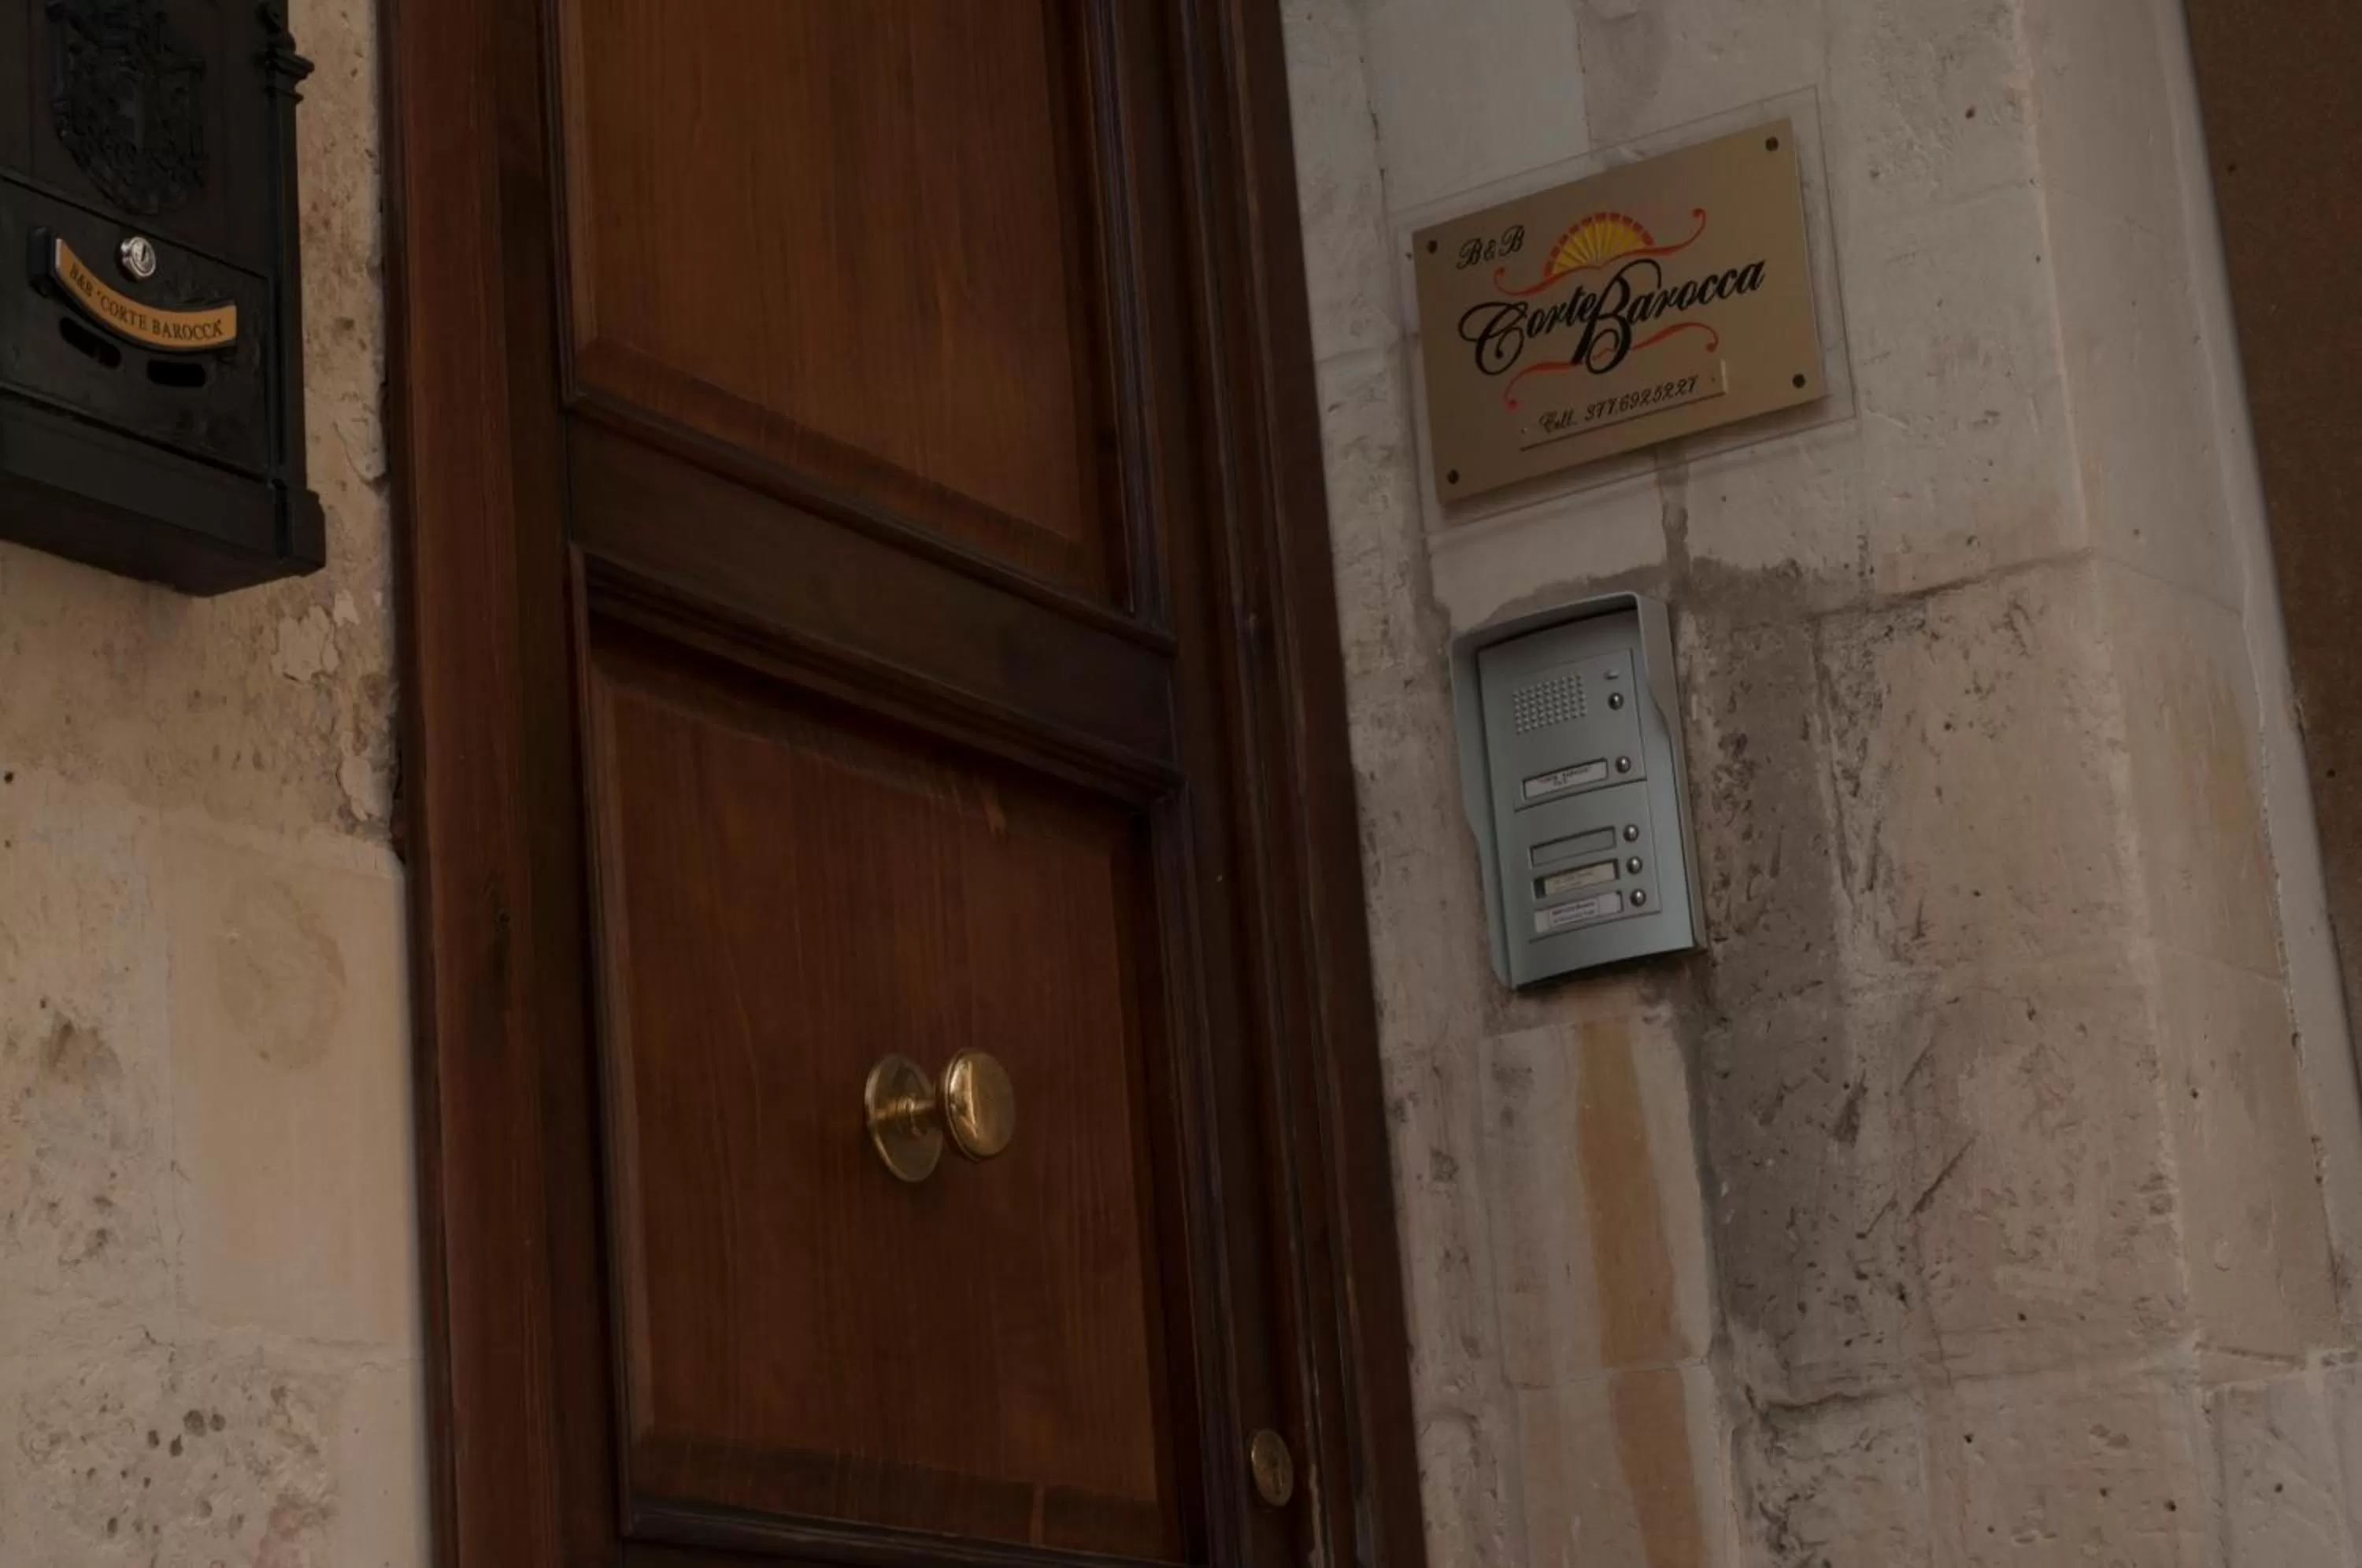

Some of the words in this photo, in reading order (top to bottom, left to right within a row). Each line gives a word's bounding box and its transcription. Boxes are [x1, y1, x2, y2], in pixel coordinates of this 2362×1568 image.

[1457, 224, 1524, 270] B&B
[1457, 283, 1597, 375] Corte
[1570, 259, 1766, 375] Barocca
